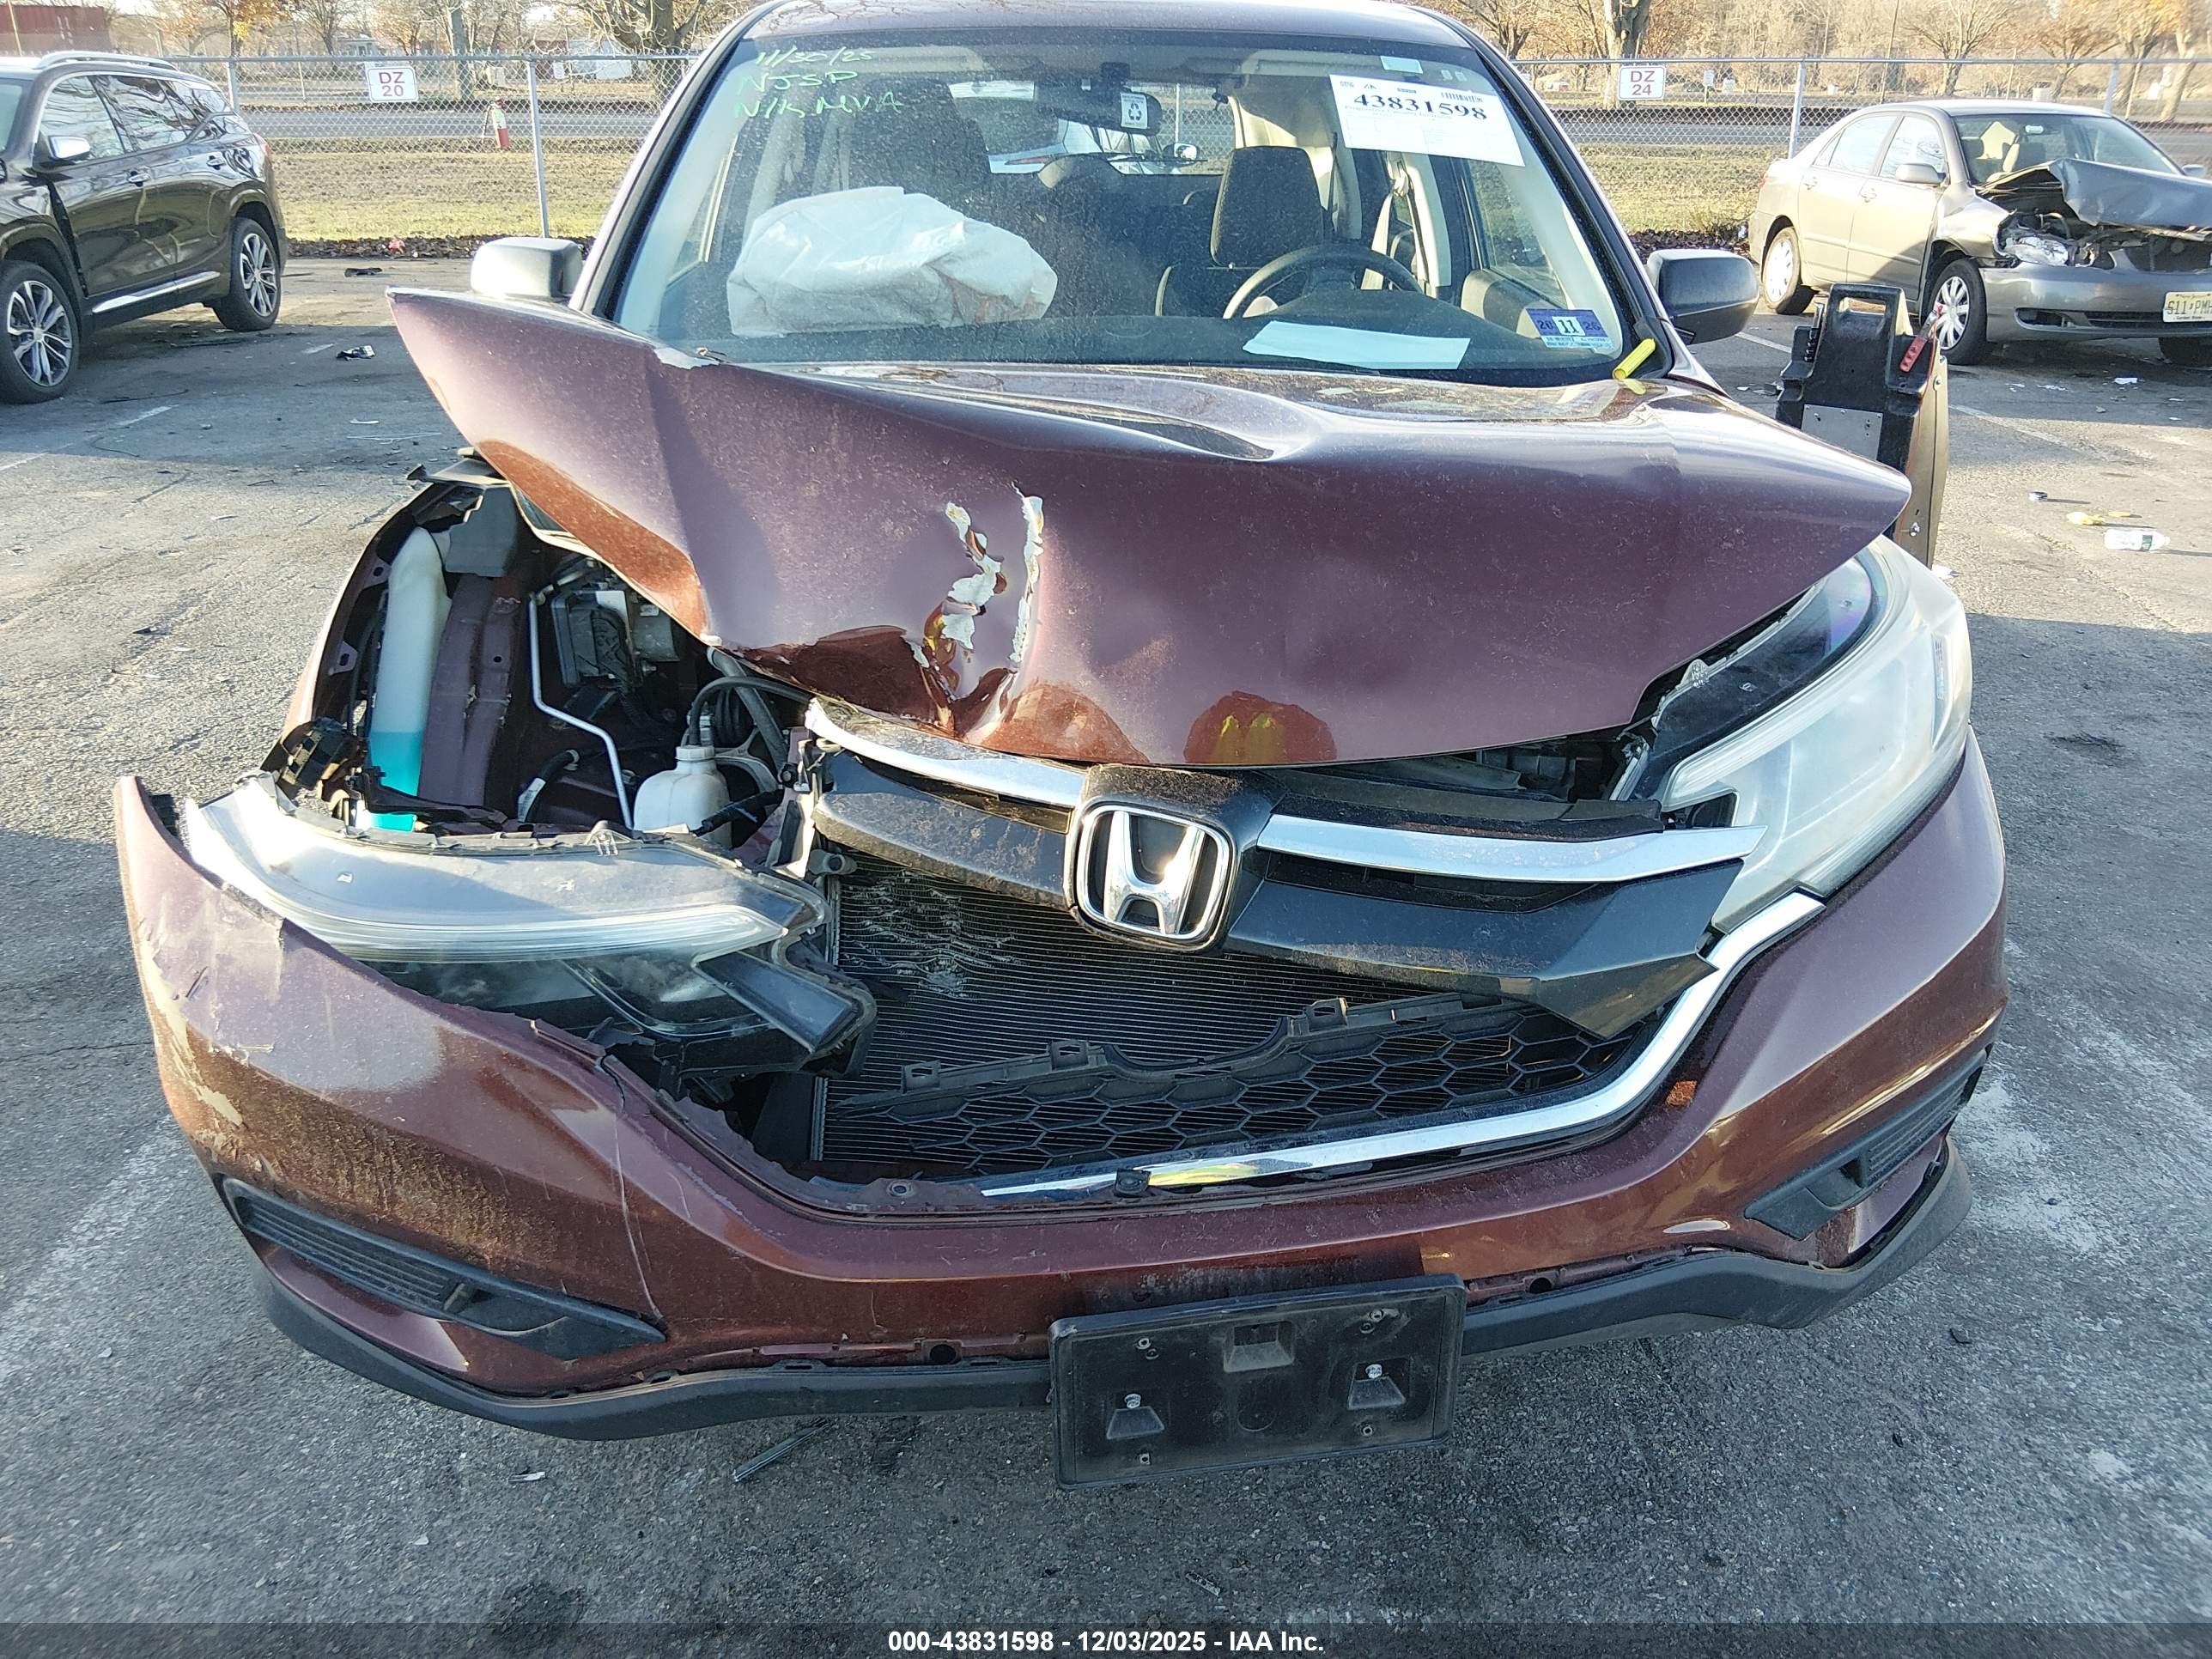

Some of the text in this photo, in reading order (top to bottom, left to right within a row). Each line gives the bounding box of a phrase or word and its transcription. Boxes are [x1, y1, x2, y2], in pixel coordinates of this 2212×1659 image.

[756, 45, 877, 68] 11/30/25
[379, 71, 405, 84] DZ
[736, 70, 858, 95] NJSP
[1630, 70, 1656, 82] DZ
[381, 84, 404, 97] 20
[1632, 83, 1652, 96] 24
[1353, 94, 1488, 120] 43831598
[1558, 319, 1580, 333] 11
